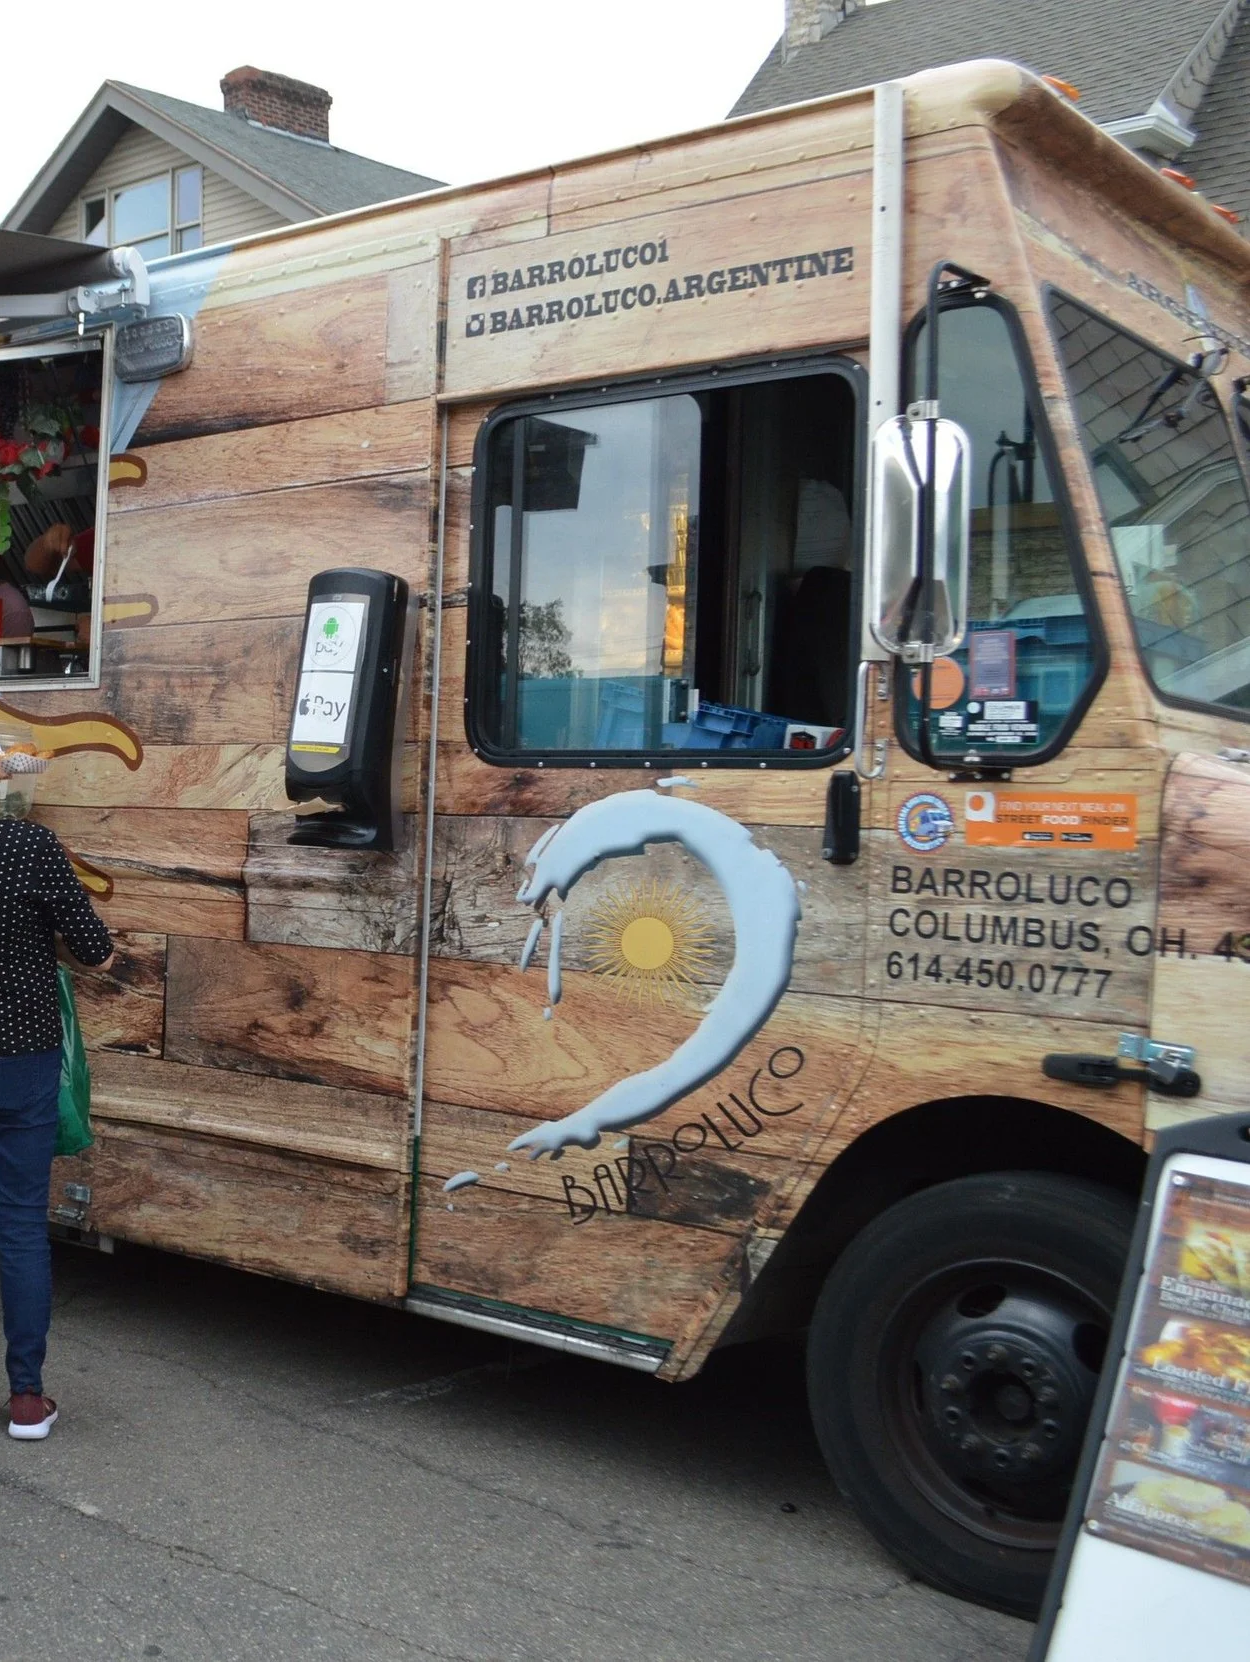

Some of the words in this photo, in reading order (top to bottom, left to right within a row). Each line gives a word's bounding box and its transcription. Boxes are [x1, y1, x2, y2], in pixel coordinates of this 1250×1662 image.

[488, 246, 855, 334] BARROLUCO.ARGENTINE
[490, 239, 670, 296] BARROLUCO1
[313, 695, 347, 722] Pay
[891, 865, 1133, 909] BARROLUCO
[888, 908, 1110, 958] COLUMBUS,
[886, 951, 1114, 999] 614.450.0777
[561, 1046, 805, 1225] BARROLUCO
[1151, 1355, 1229, 1388] Loaded
[1103, 1491, 1198, 1530] Alfajores
